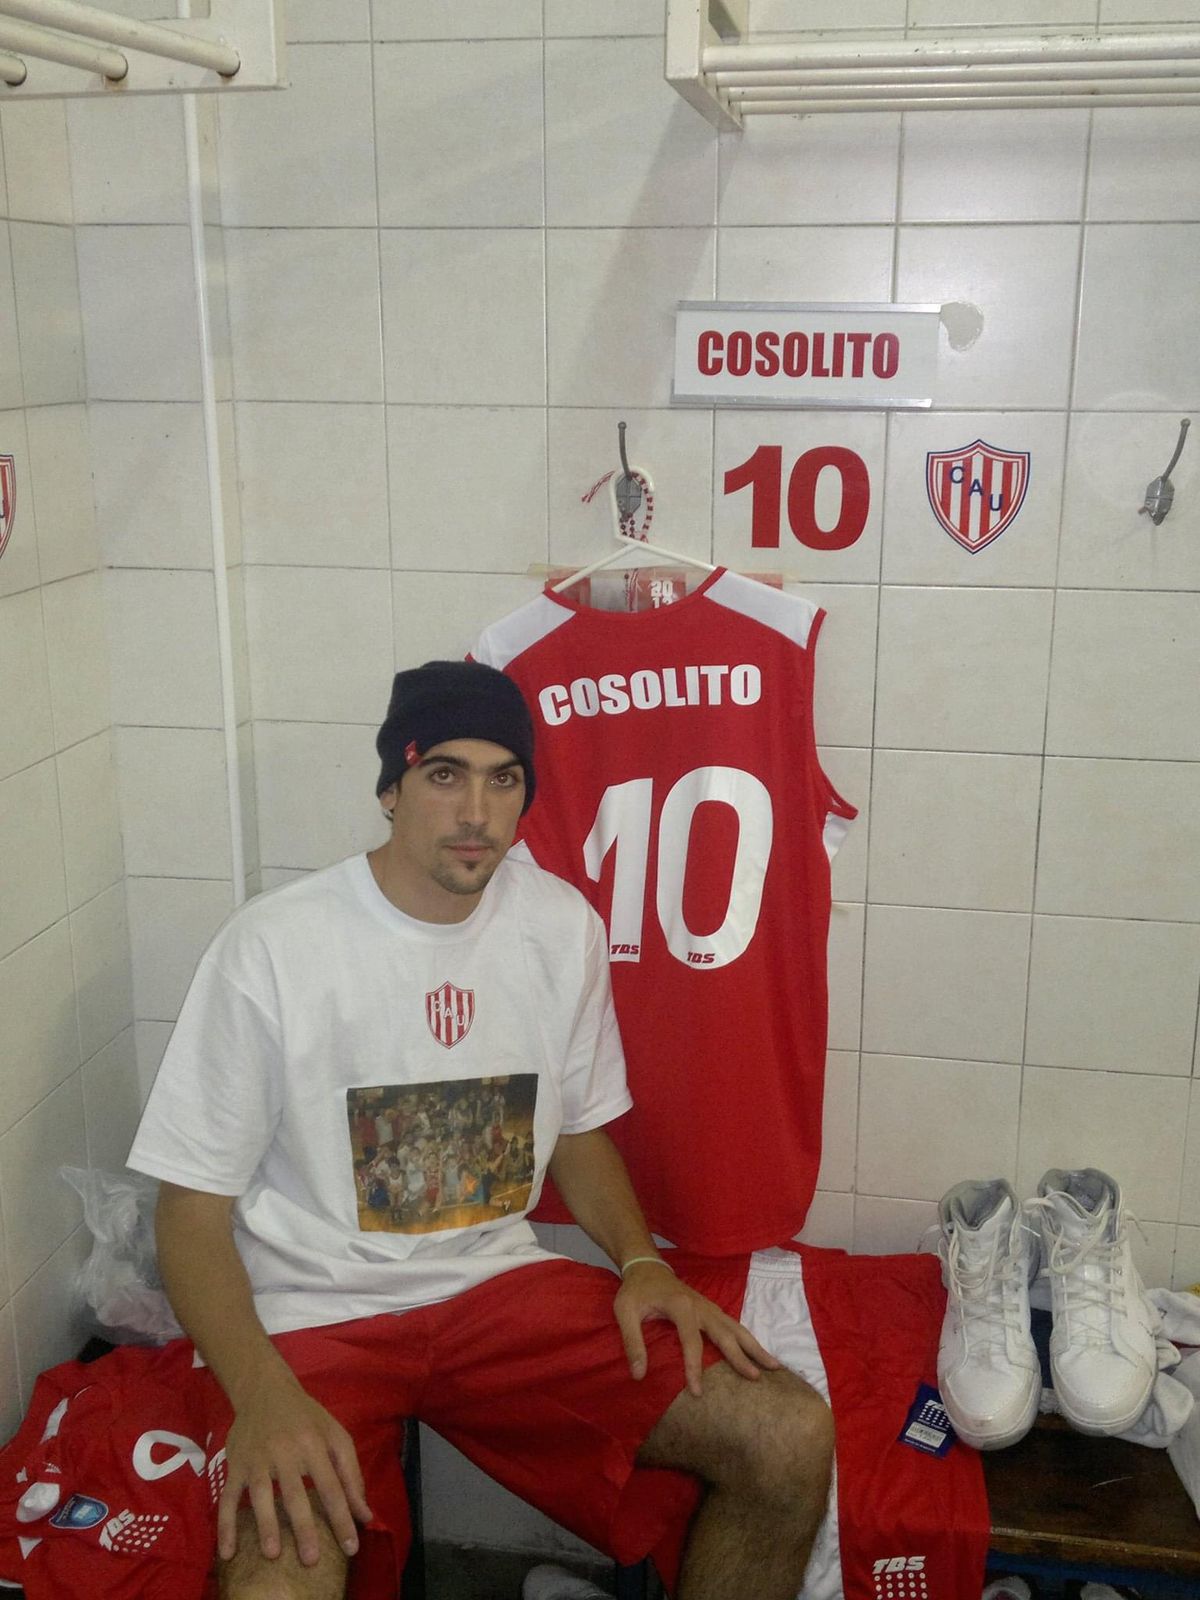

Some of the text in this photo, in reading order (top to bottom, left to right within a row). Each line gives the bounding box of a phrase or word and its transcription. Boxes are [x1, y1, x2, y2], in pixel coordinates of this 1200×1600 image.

[697, 330, 900, 379] COSOLITO
[724, 445, 870, 551] 10
[538, 664, 762, 726] COSOLITO
[583, 766, 774, 970] 10
[99, 1508, 136, 1551] TBS
[872, 1555, 926, 1575] TBS
